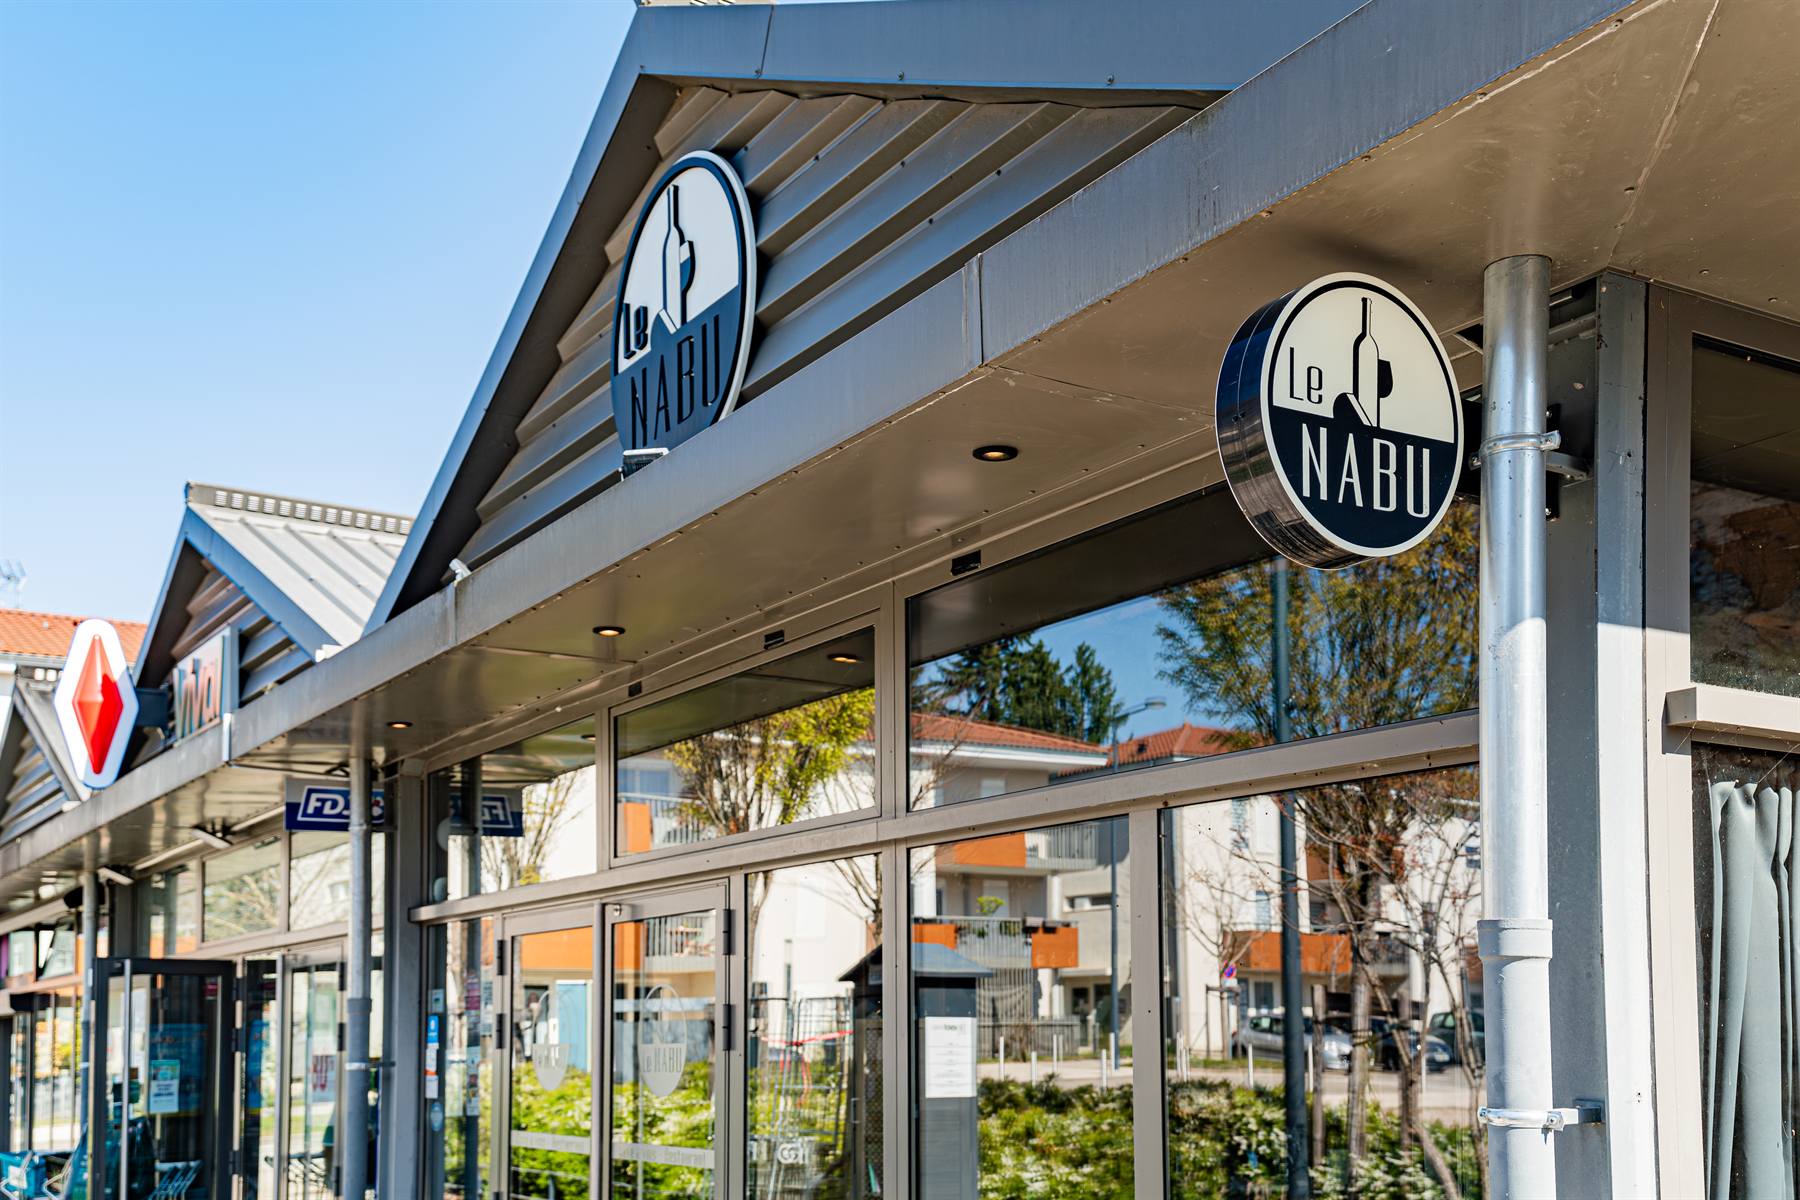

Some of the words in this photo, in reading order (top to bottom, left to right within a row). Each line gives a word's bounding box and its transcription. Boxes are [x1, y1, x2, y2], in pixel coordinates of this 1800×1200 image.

[622, 302, 649, 360] Le
[631, 313, 720, 449] NABU
[1289, 346, 1323, 405] Le
[1302, 423, 1430, 518] NABU
[306, 792, 350, 816] FD
